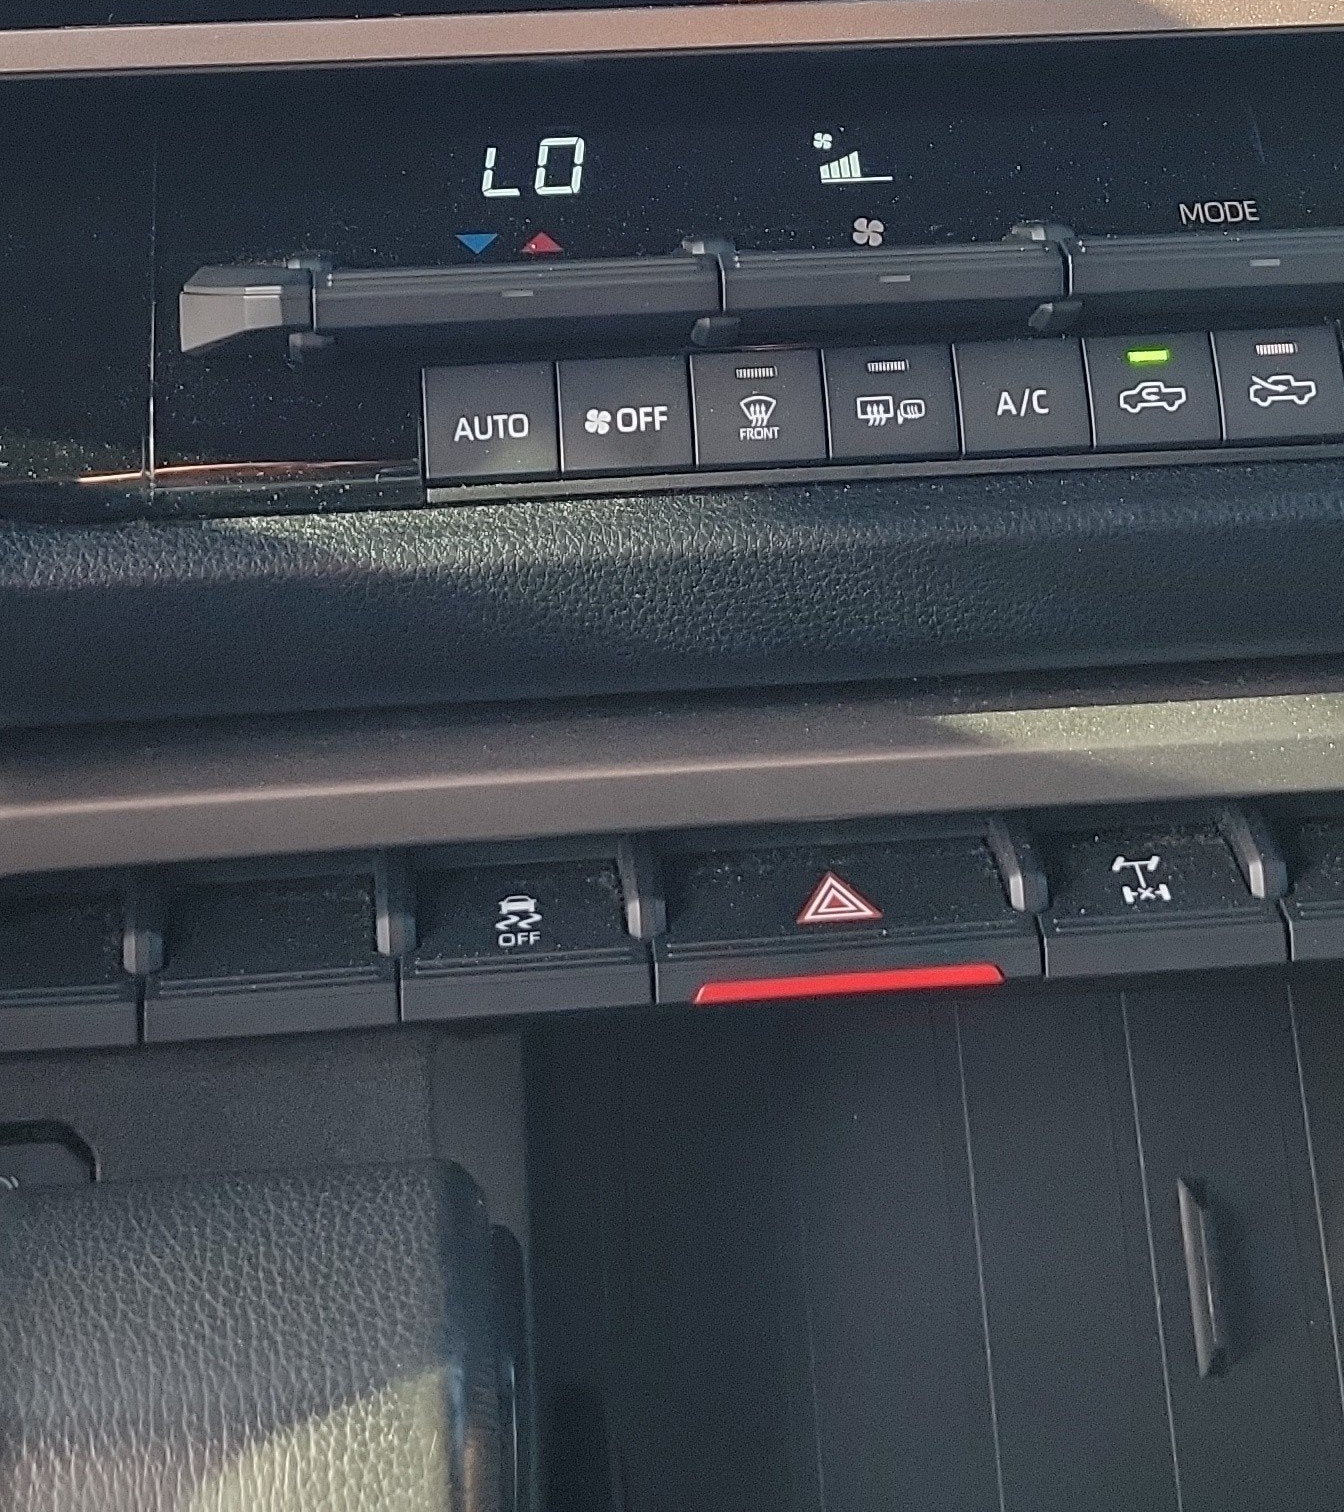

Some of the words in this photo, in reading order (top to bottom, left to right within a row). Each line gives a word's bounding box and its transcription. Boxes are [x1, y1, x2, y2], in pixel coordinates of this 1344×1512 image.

[481, 136, 585, 197] LO
[1178, 200, 1260, 225] MODE
[996, 388, 1050, 417] A/C
[454, 413, 530, 442] AUTO
[616, 406, 668, 433] OFF
[739, 426, 780, 441] FRONT
[498, 931, 541, 947] OFF
